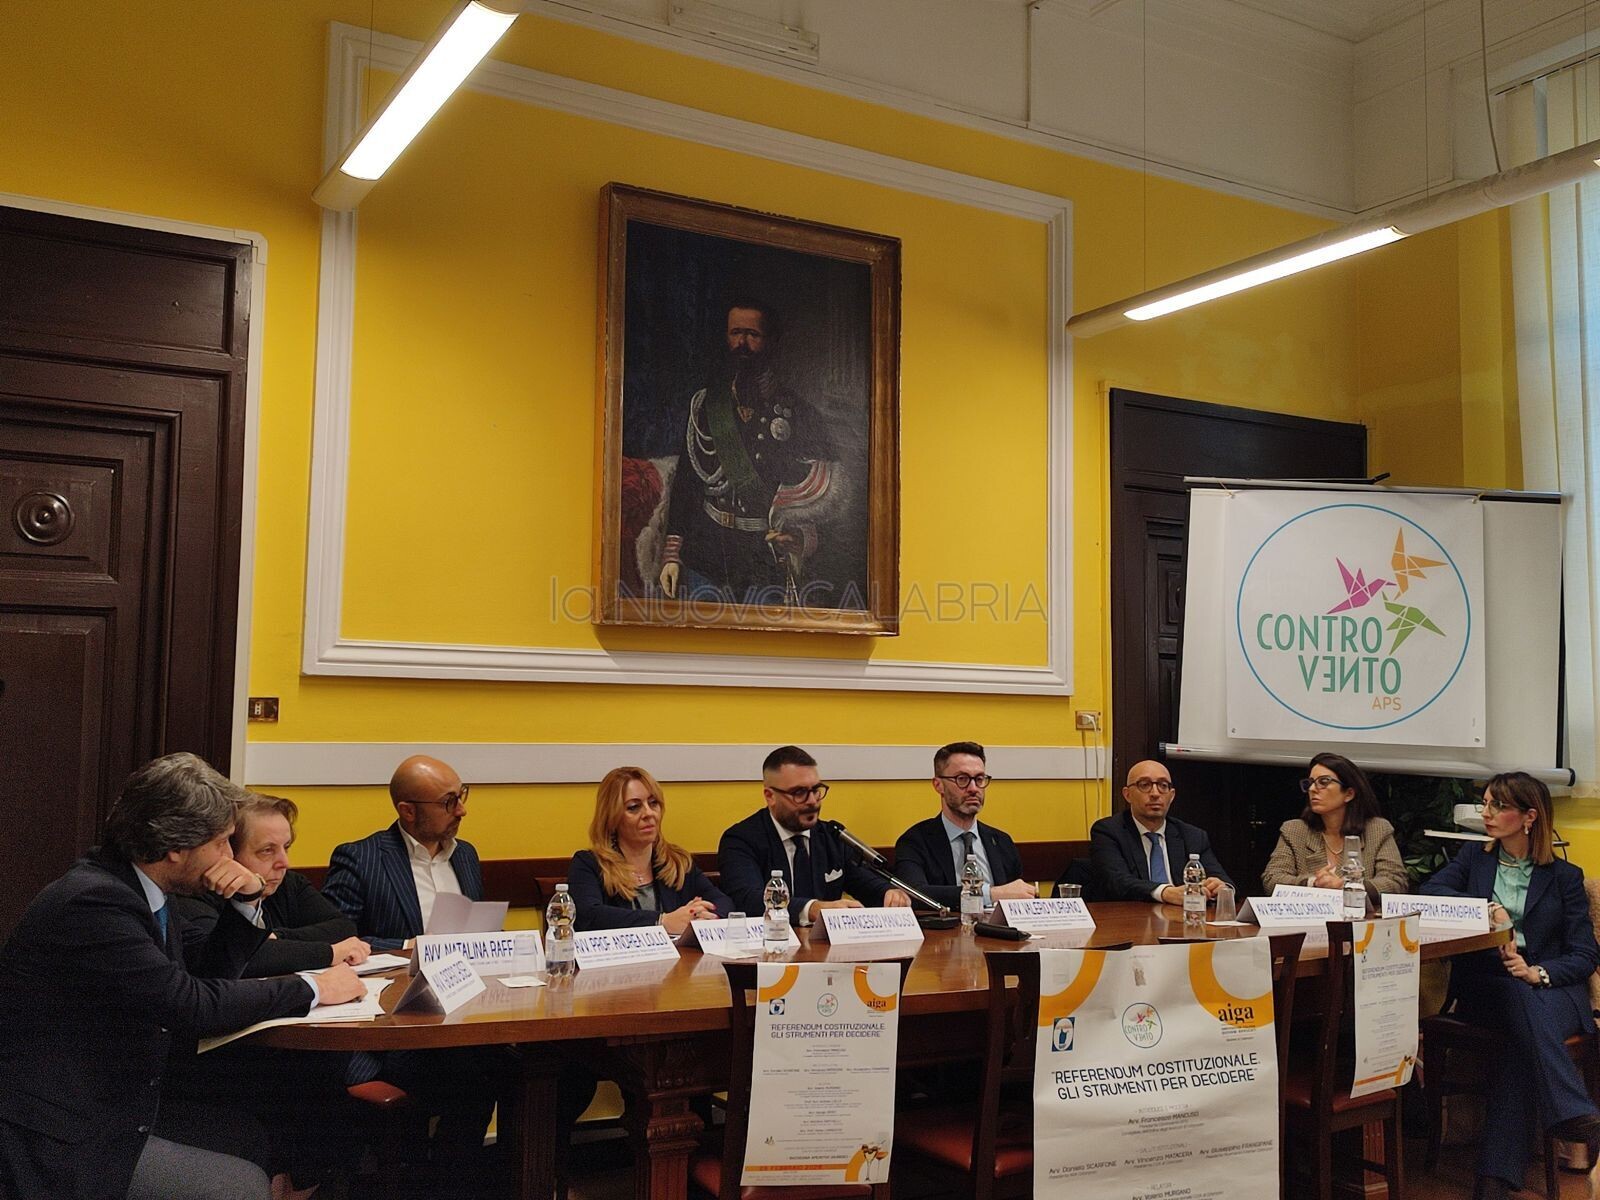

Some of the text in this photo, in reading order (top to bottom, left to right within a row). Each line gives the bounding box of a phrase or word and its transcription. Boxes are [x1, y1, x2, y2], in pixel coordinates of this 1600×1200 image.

[1257, 613, 1382, 654] CONTRO
[1371, 697, 1401, 711] APS
[1217, 1002, 1255, 1025] aiga
[1058, 1086, 1080, 1100] GLI
[1082, 1080, 1158, 1098] STRUMENTI
[1160, 1076, 1188, 1091] PER
